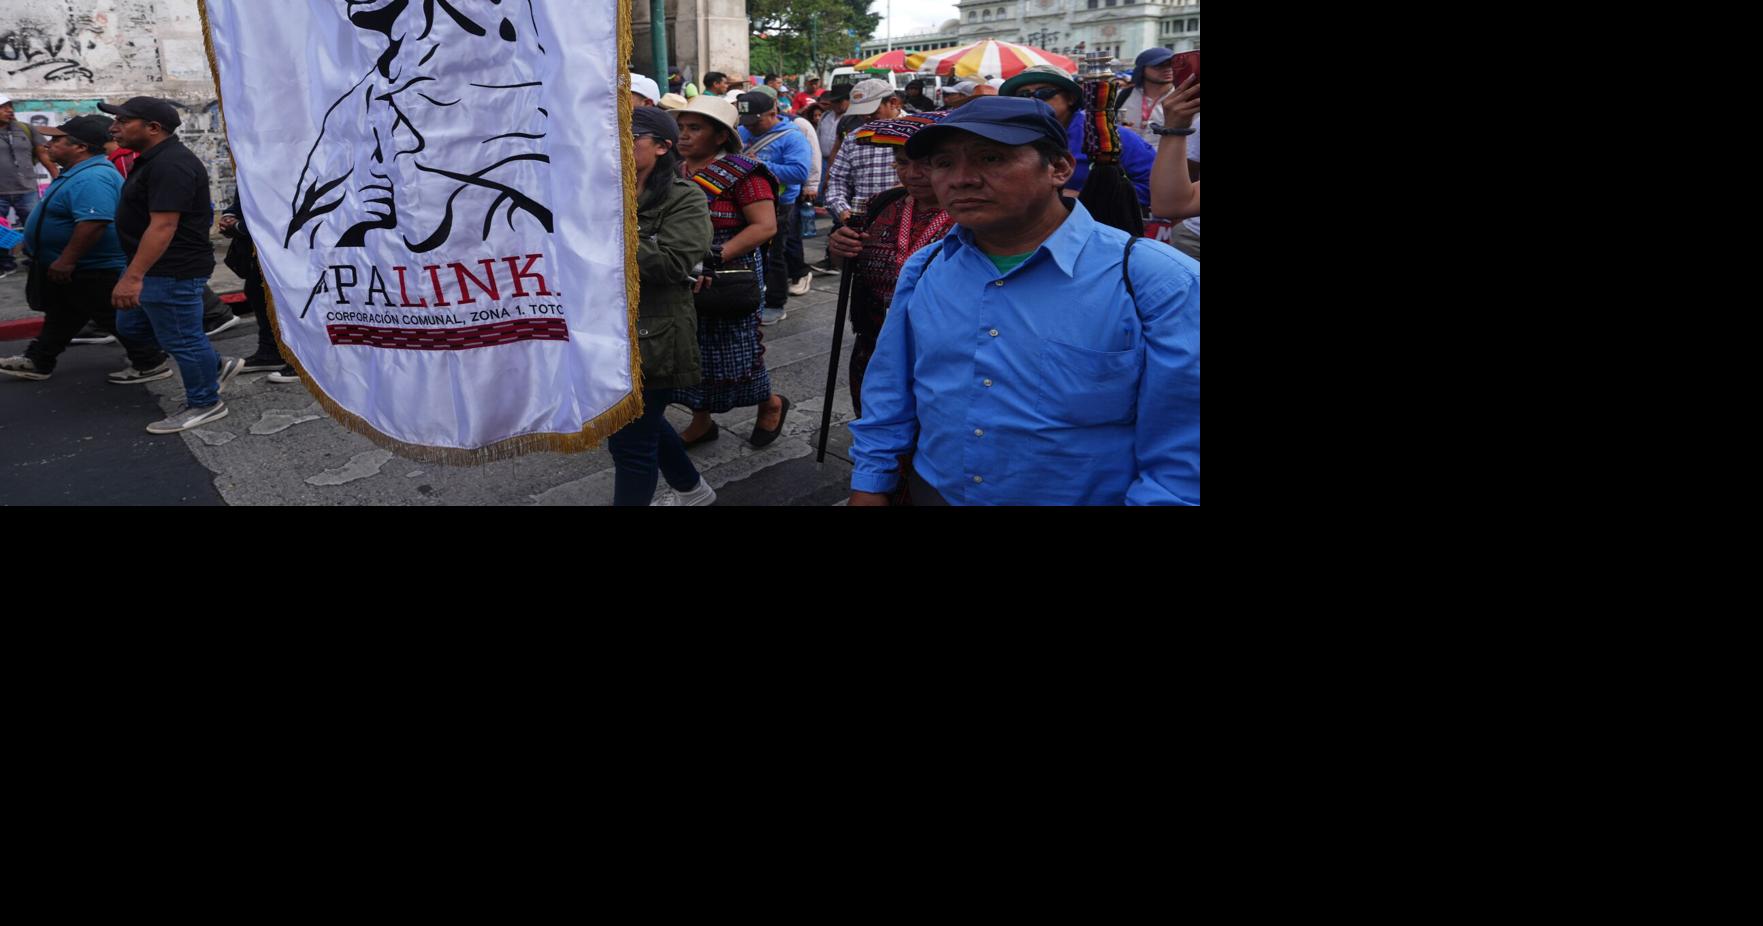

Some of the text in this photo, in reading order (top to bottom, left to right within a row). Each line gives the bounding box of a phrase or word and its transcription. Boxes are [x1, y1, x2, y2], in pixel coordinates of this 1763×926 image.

[326, 310, 400, 325] CORPORACIÓN
[402, 313, 467, 326] COMUNAL,
[470, 308, 511, 322] ZONA
[515, 305, 526, 317] 1.
